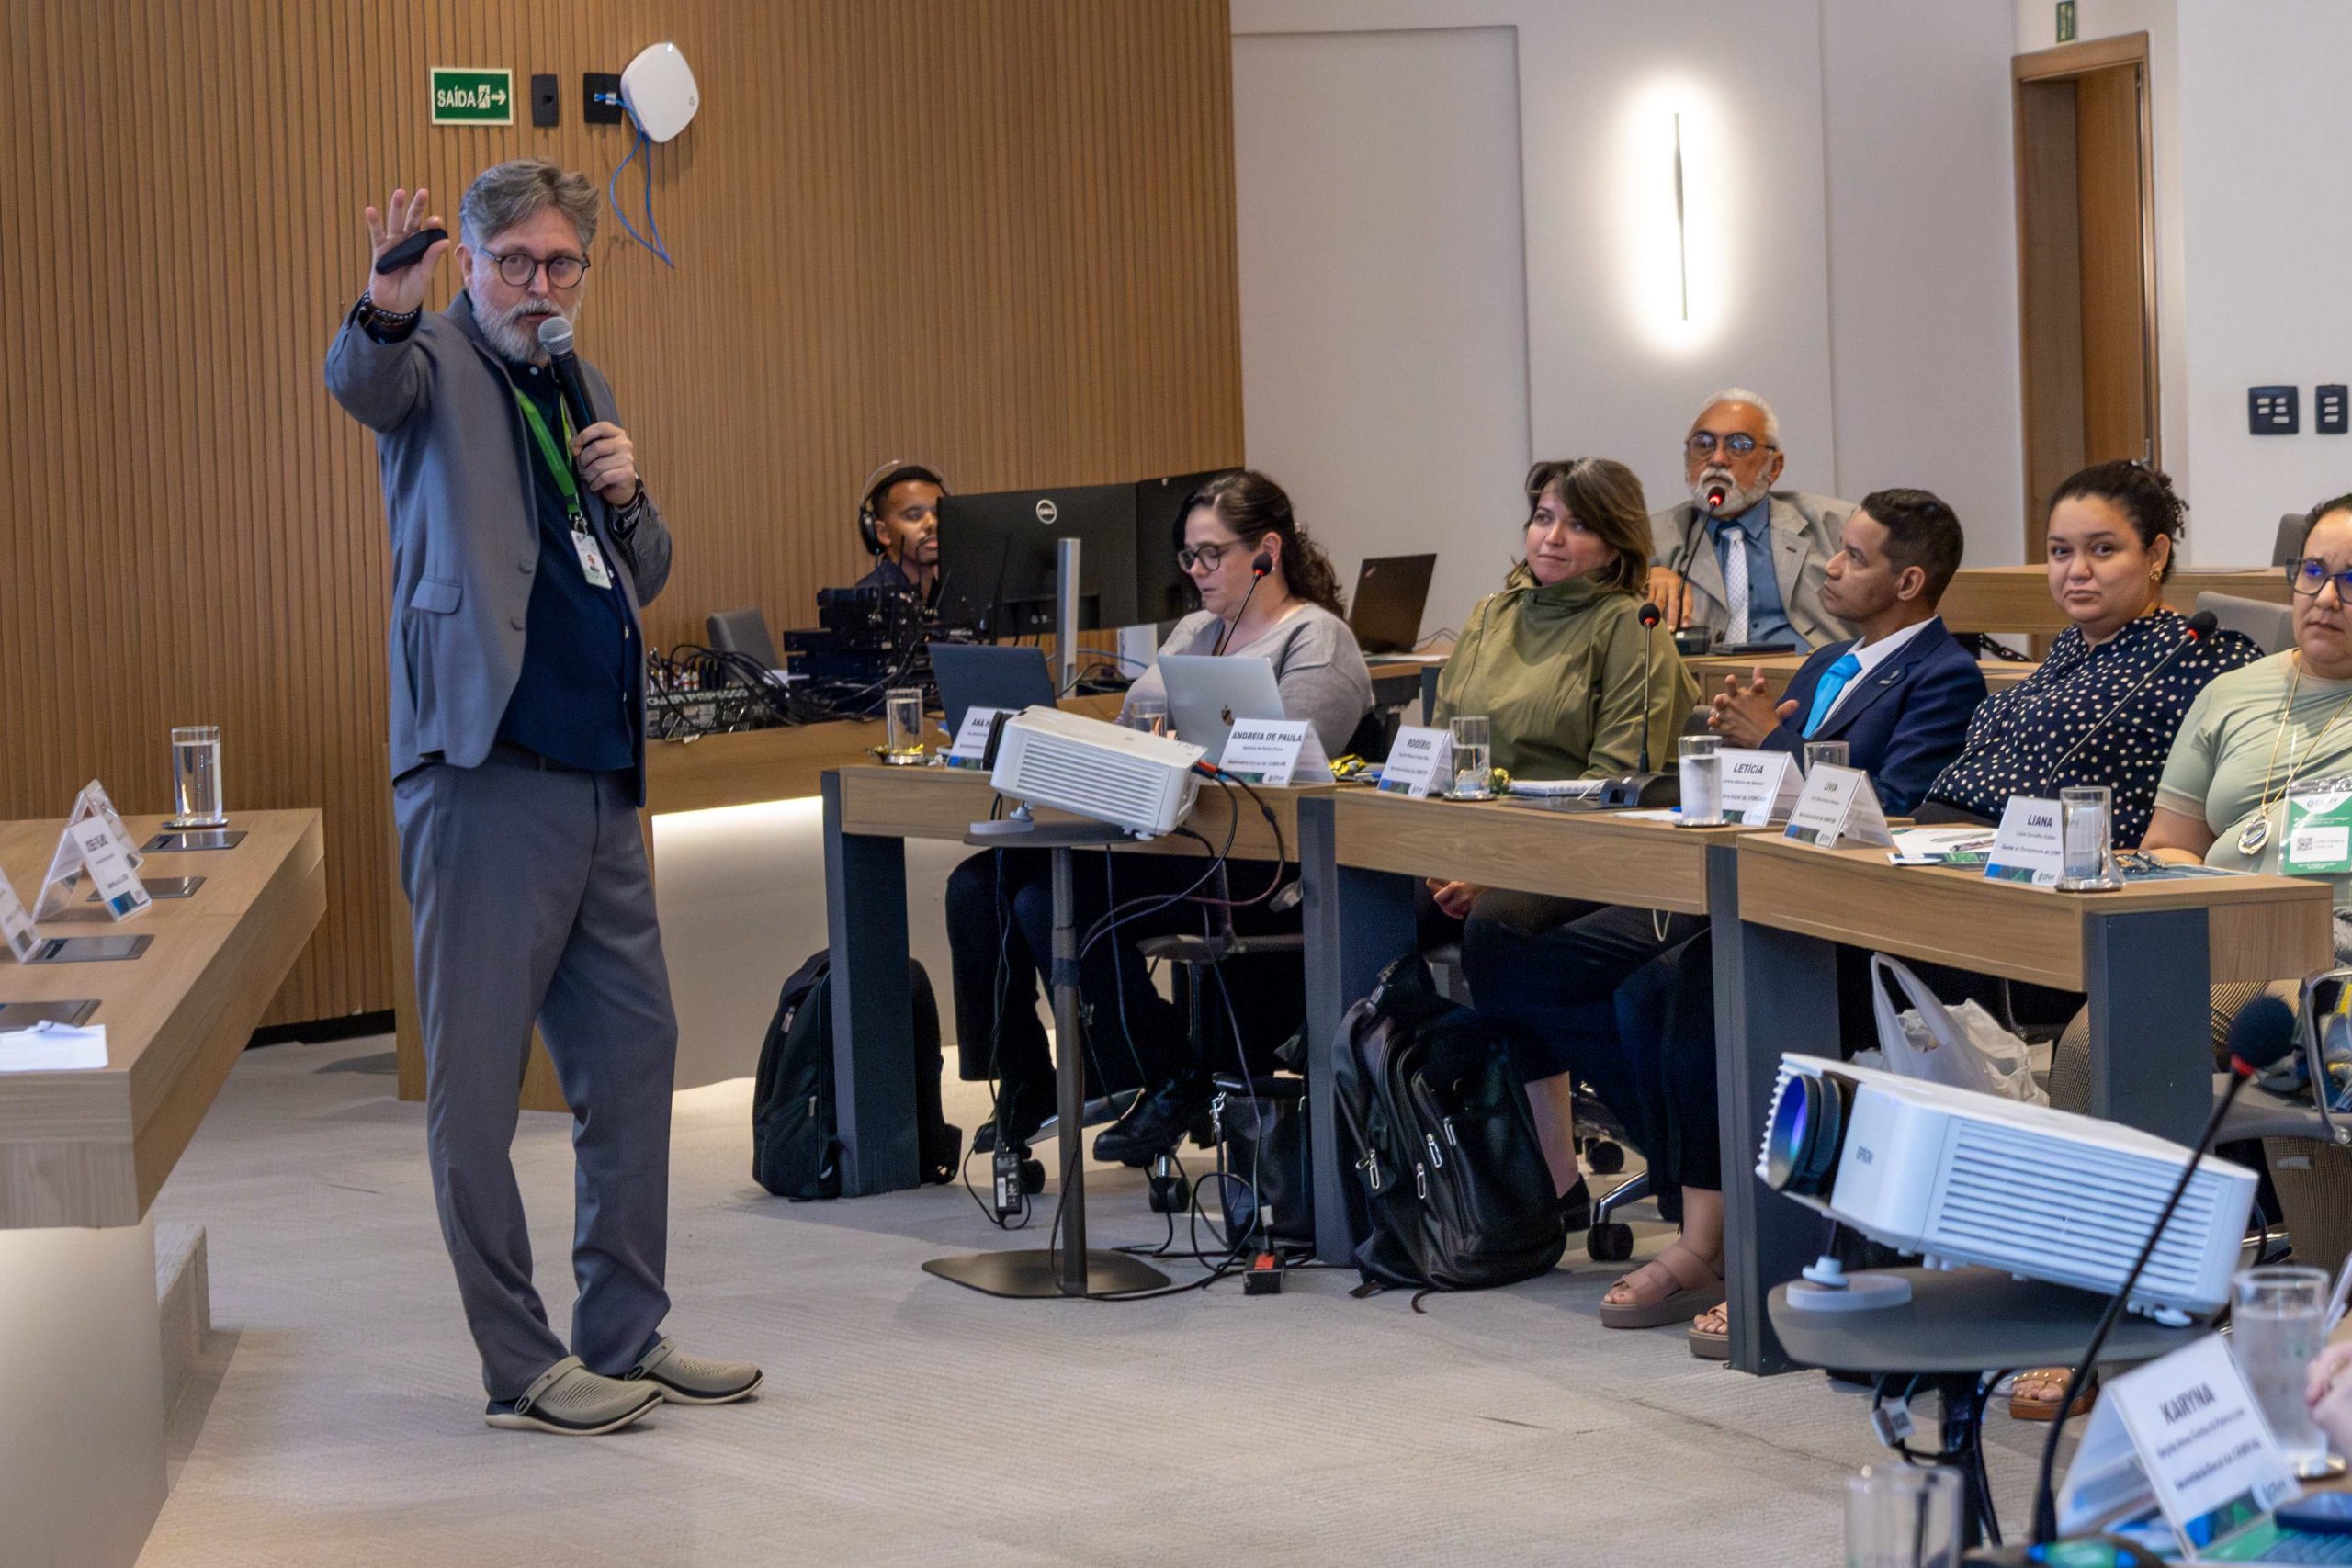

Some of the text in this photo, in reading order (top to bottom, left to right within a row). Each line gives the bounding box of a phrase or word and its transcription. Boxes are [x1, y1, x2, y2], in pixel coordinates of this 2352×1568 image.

[437, 85, 476, 107] SAÍDA
[1231, 731, 1302, 742] ANDREIA DE PAULA
[2027, 814, 2052, 828] LIANA
[2159, 1382, 2215, 1425] KARYNA
